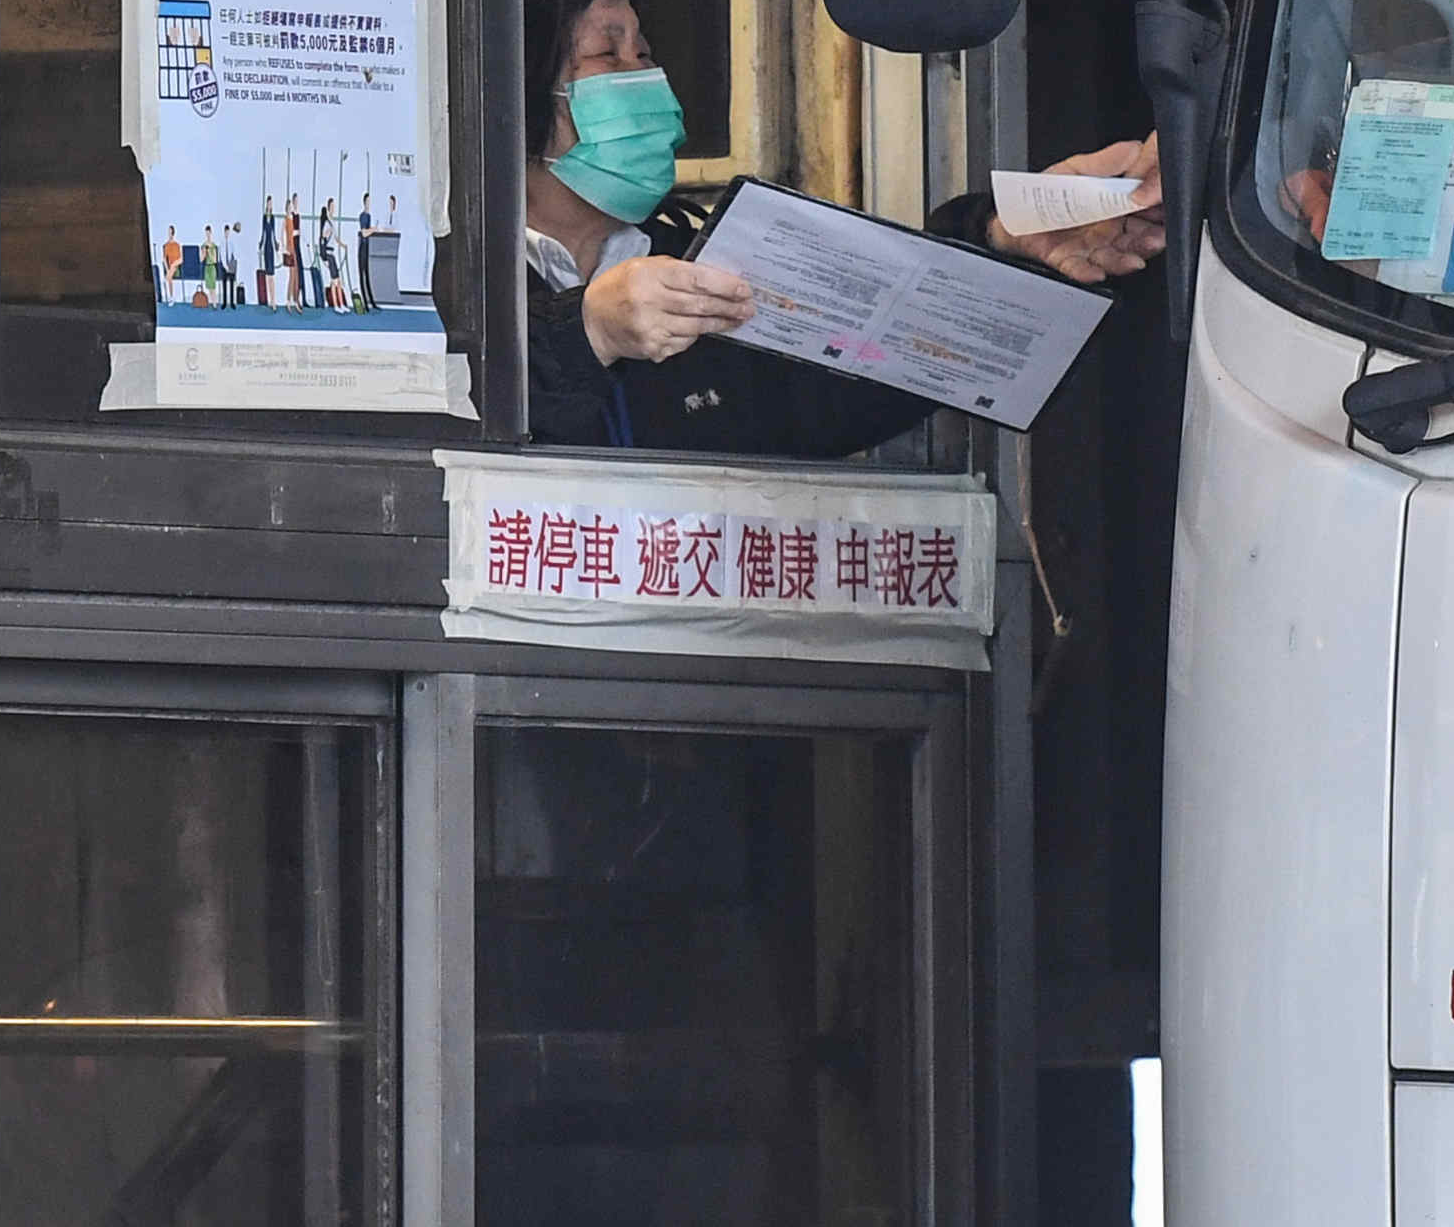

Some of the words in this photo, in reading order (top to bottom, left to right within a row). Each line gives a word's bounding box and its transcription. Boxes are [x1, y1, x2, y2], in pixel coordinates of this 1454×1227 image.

[223, 72, 242, 84] FALSE
[225, 88, 239, 100] FINE
[241, 89, 249, 100] OF
[488, 508, 620, 599] 請停車
[637, 516, 723, 599] 遞交
[737, 523, 820, 601] 健康
[835, 526, 960, 608] 申報表
